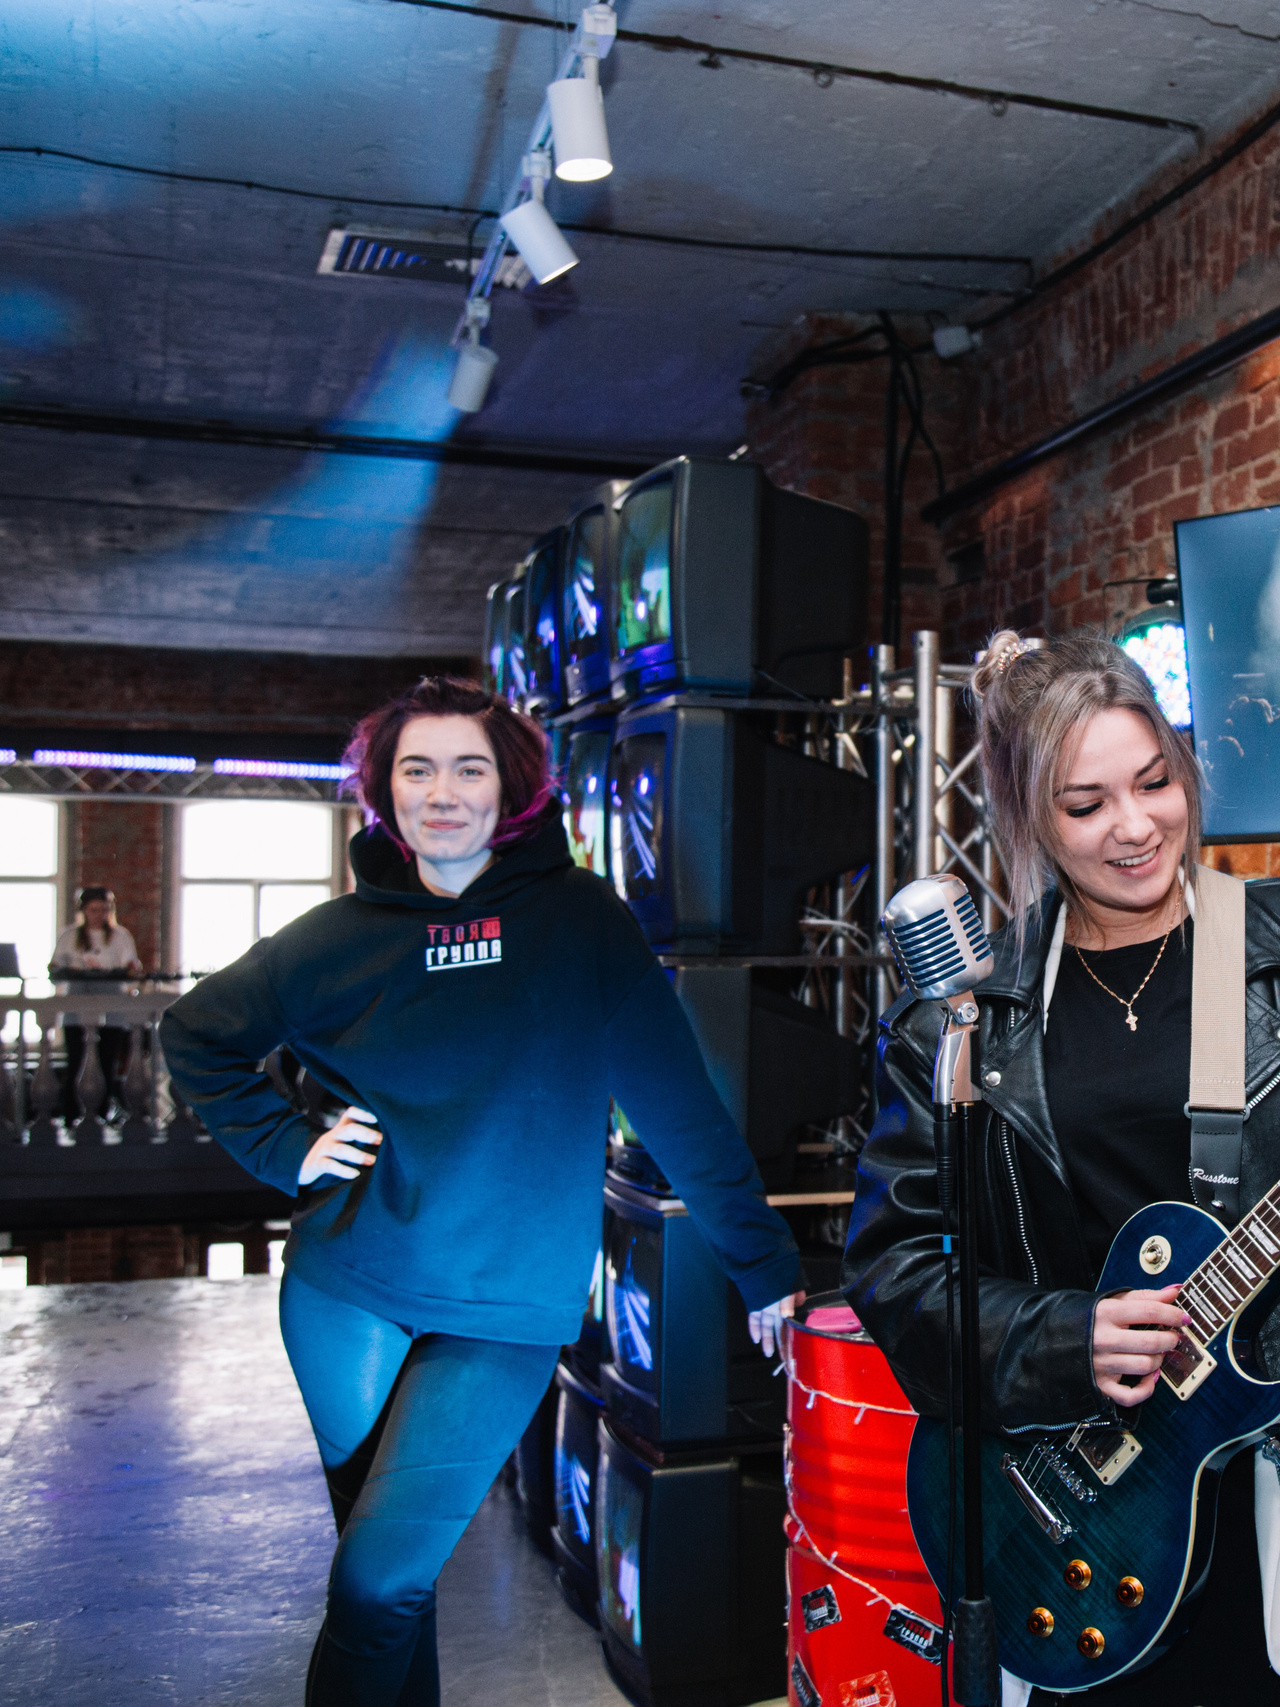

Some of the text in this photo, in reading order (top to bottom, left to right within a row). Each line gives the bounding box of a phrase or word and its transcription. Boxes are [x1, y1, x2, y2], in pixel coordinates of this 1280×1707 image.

[427, 923, 479, 946] ТВОЯ
[426, 939, 502, 966] ГРУППА
[1192, 1167, 1240, 1185] Russtone
